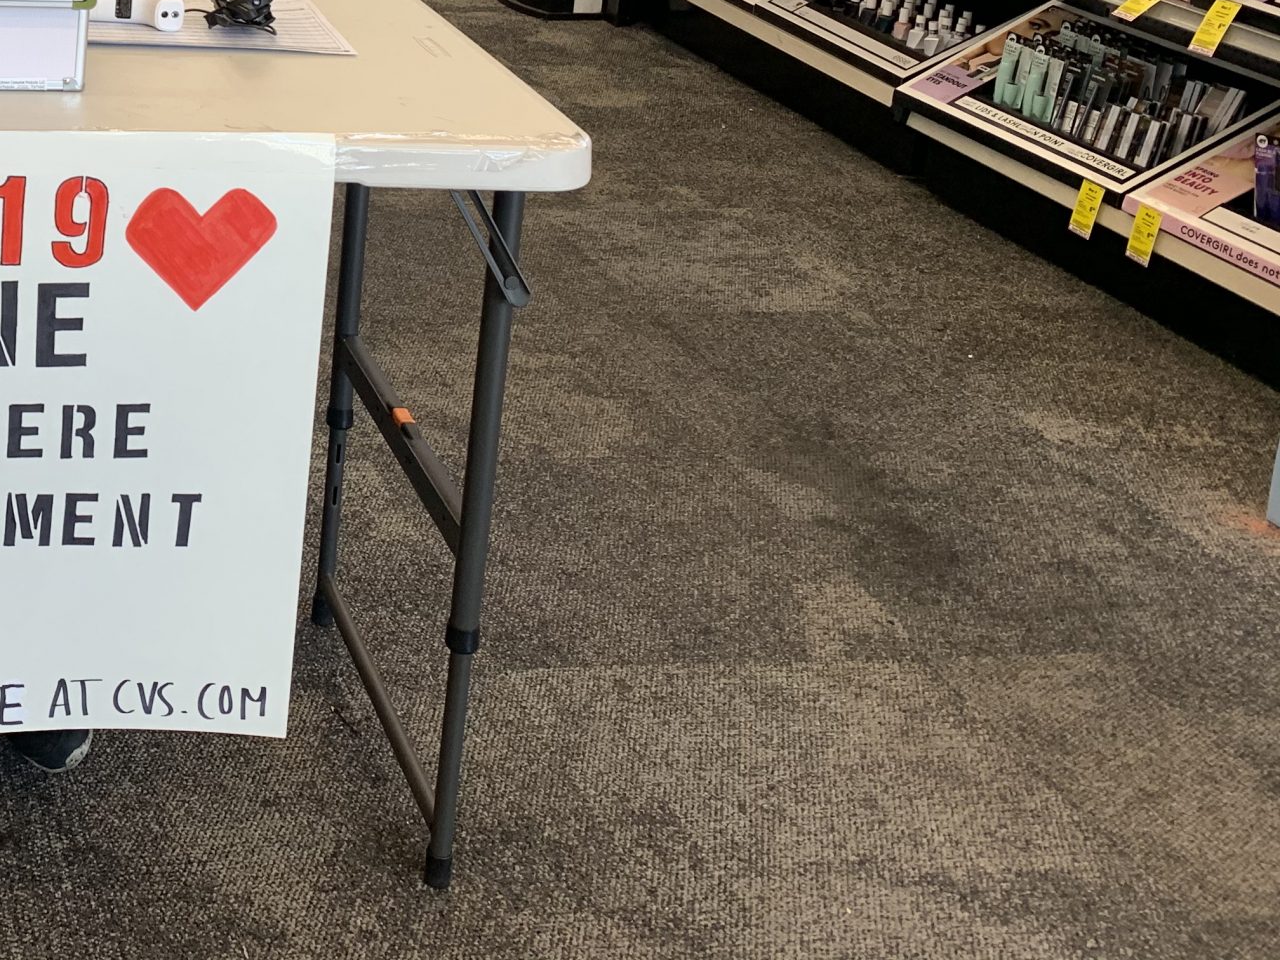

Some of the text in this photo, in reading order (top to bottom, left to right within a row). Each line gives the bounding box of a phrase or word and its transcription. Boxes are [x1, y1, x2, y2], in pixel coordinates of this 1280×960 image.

[925, 76, 942, 86] EYES
[933, 72, 968, 89] STANDOUT
[975, 105, 992, 115] LIDS
[1038, 133, 1065, 147] POINT
[1184, 170, 1213, 183] INTO
[1195, 166, 1219, 178] SPRING
[1174, 175, 1219, 195] BEAUTY
[1180, 225, 1234, 258] COVERGIRL
[1236, 253, 1259, 269] does
[49, 677, 103, 720] AT
[114, 675, 268, 722] CVS.COM
